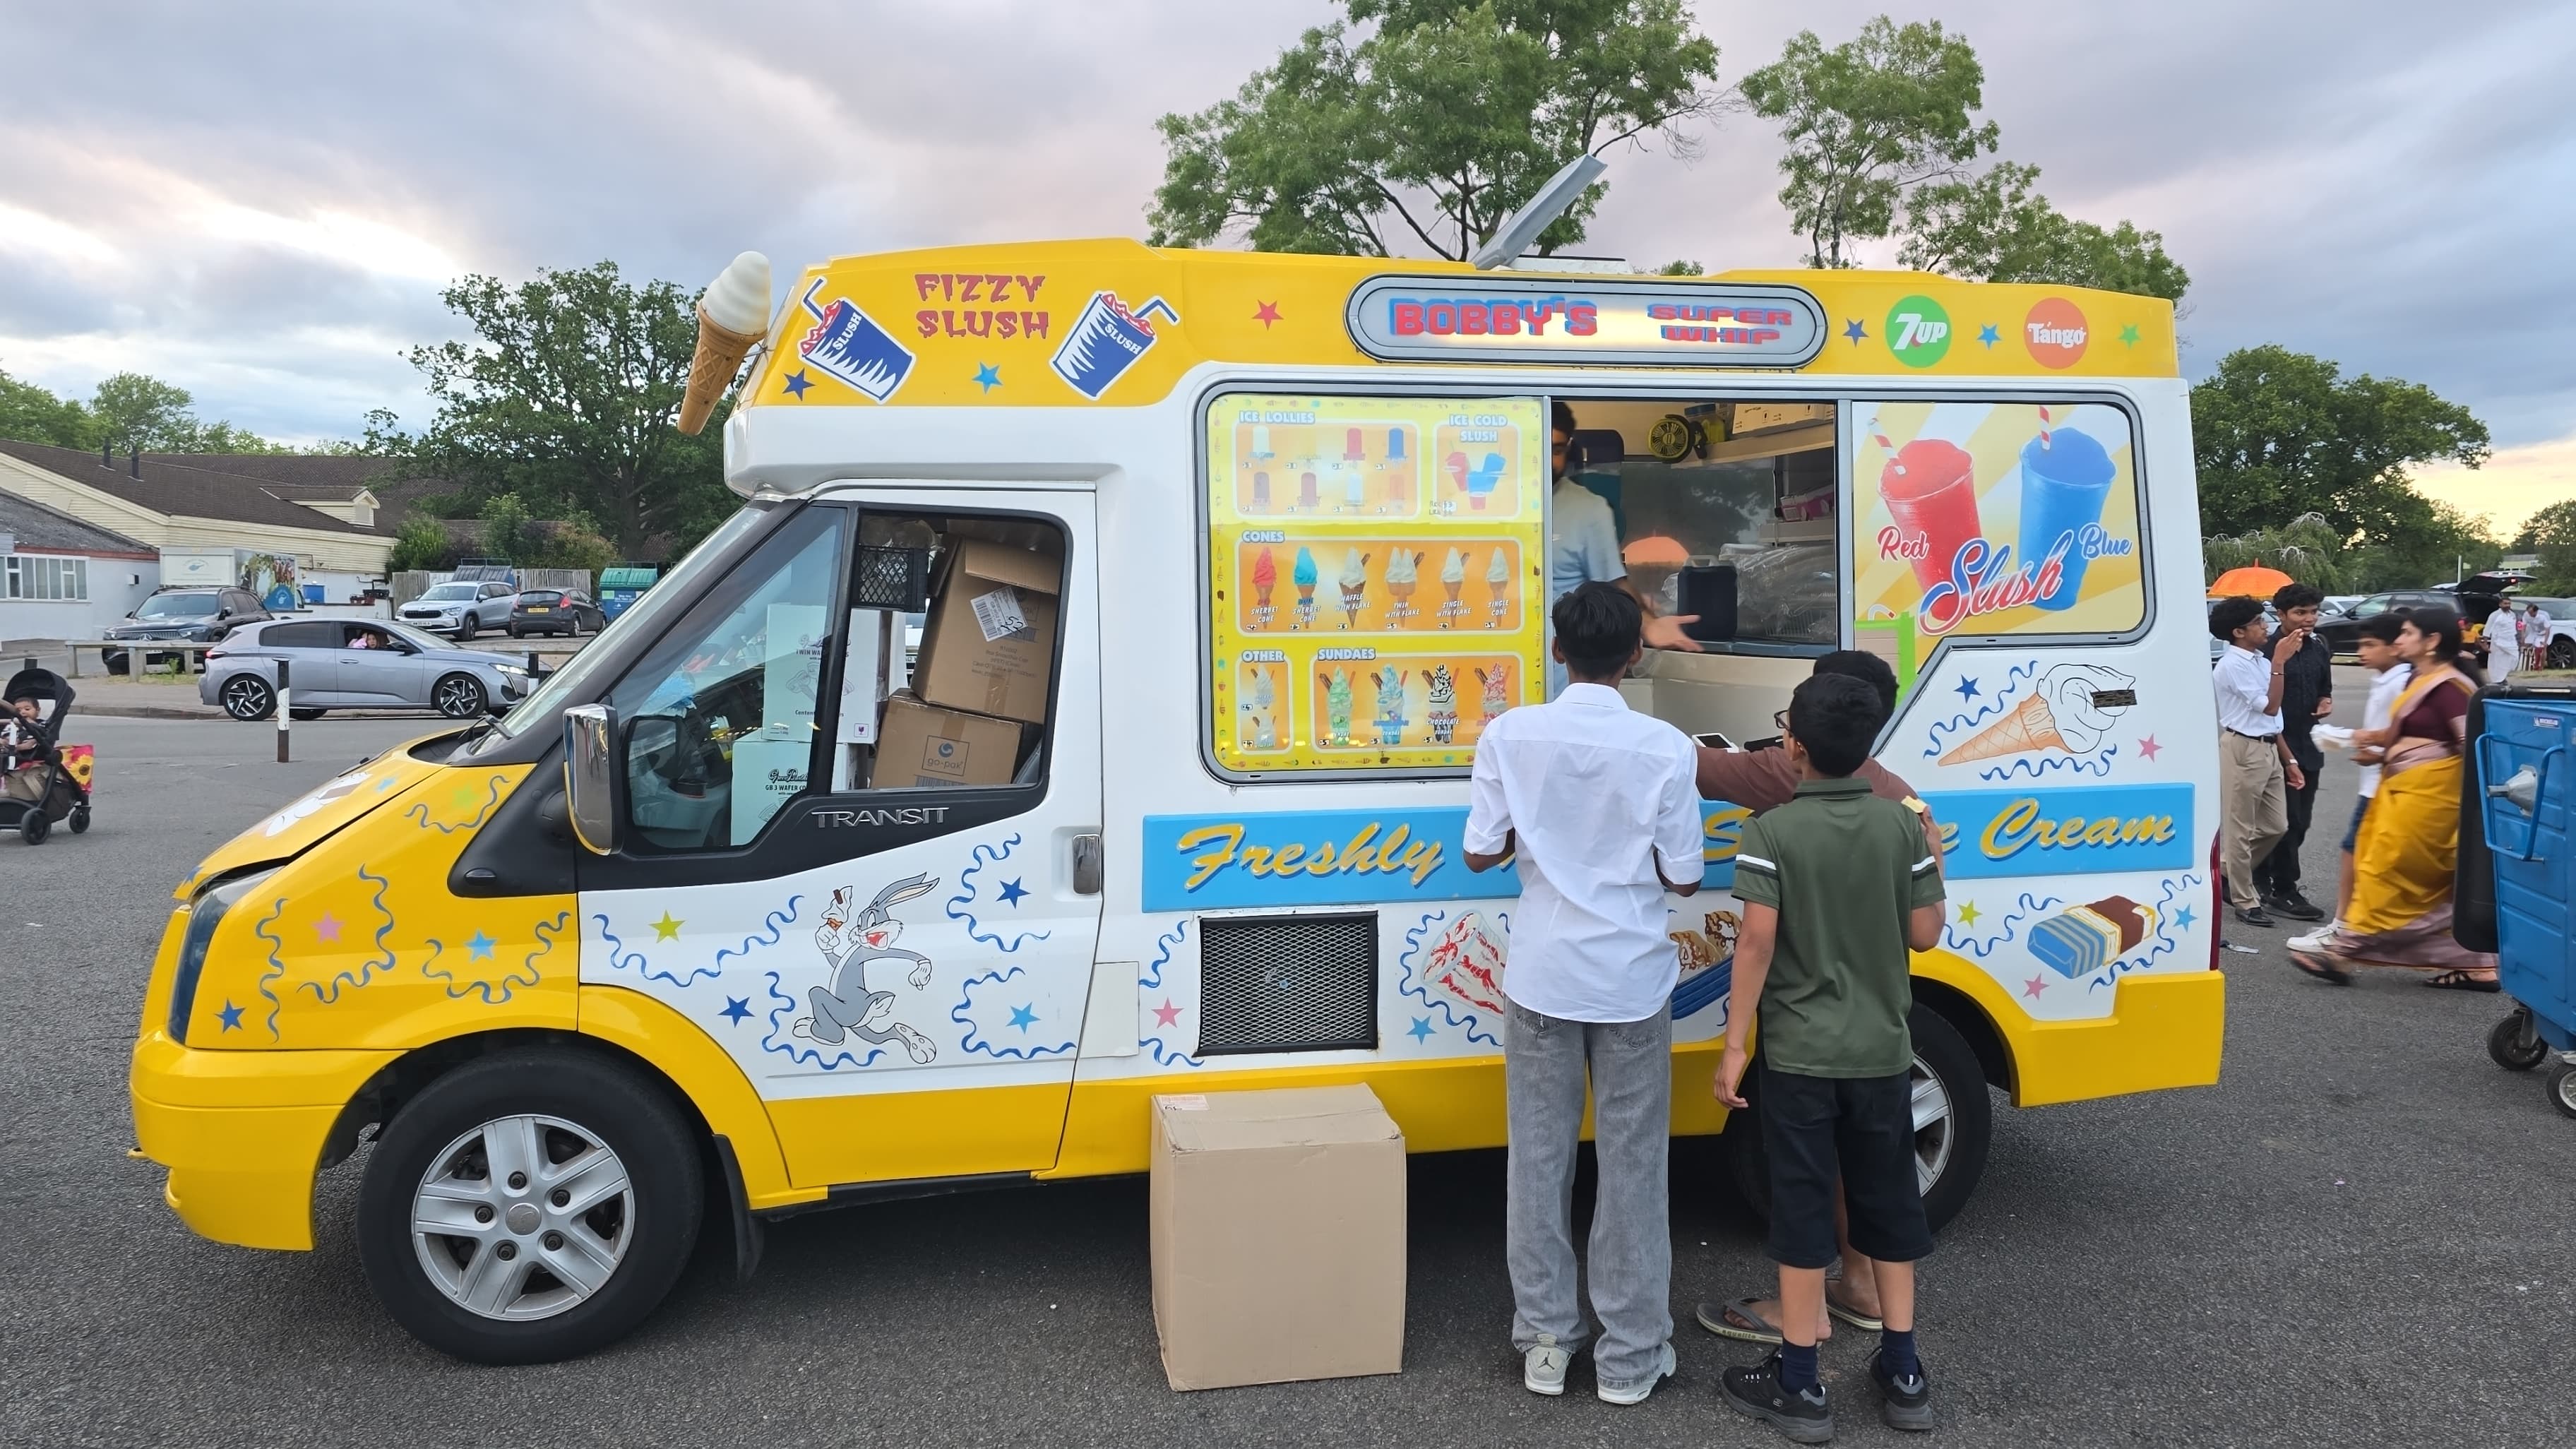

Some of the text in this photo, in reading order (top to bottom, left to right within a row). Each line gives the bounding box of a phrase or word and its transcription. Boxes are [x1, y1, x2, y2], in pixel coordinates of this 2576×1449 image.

[914, 274, 1046, 303] FIZZY
[916, 311, 1050, 340] SLUSH
[1389, 296, 1597, 336] BOBBY'S
[1647, 304, 1793, 325] SUPER
[832, 312, 862, 351] SLUSH
[1104, 322, 1142, 355] SLUSH
[1661, 326, 1780, 345] WHIP
[1893, 313, 1947, 350] 7UP
[2027, 321, 2087, 349] Tango
[1239, 411, 1316, 424] ICE LOLLIES
[1449, 415, 1508, 427] ICE COLD
[1459, 430, 1498, 443] SLUSH
[1242, 530, 1285, 543] CONES
[1877, 525, 1930, 561] Red
[2079, 523, 2133, 560] Blue
[1919, 530, 2075, 636] Slush
[1242, 650, 1285, 662] OTHER
[1318, 648, 1376, 660] SUNDAES
[811, 807, 949, 828] TRANSIT
[1980, 797, 2175, 860] Cream
[1176, 821, 1445, 893] Freshly
